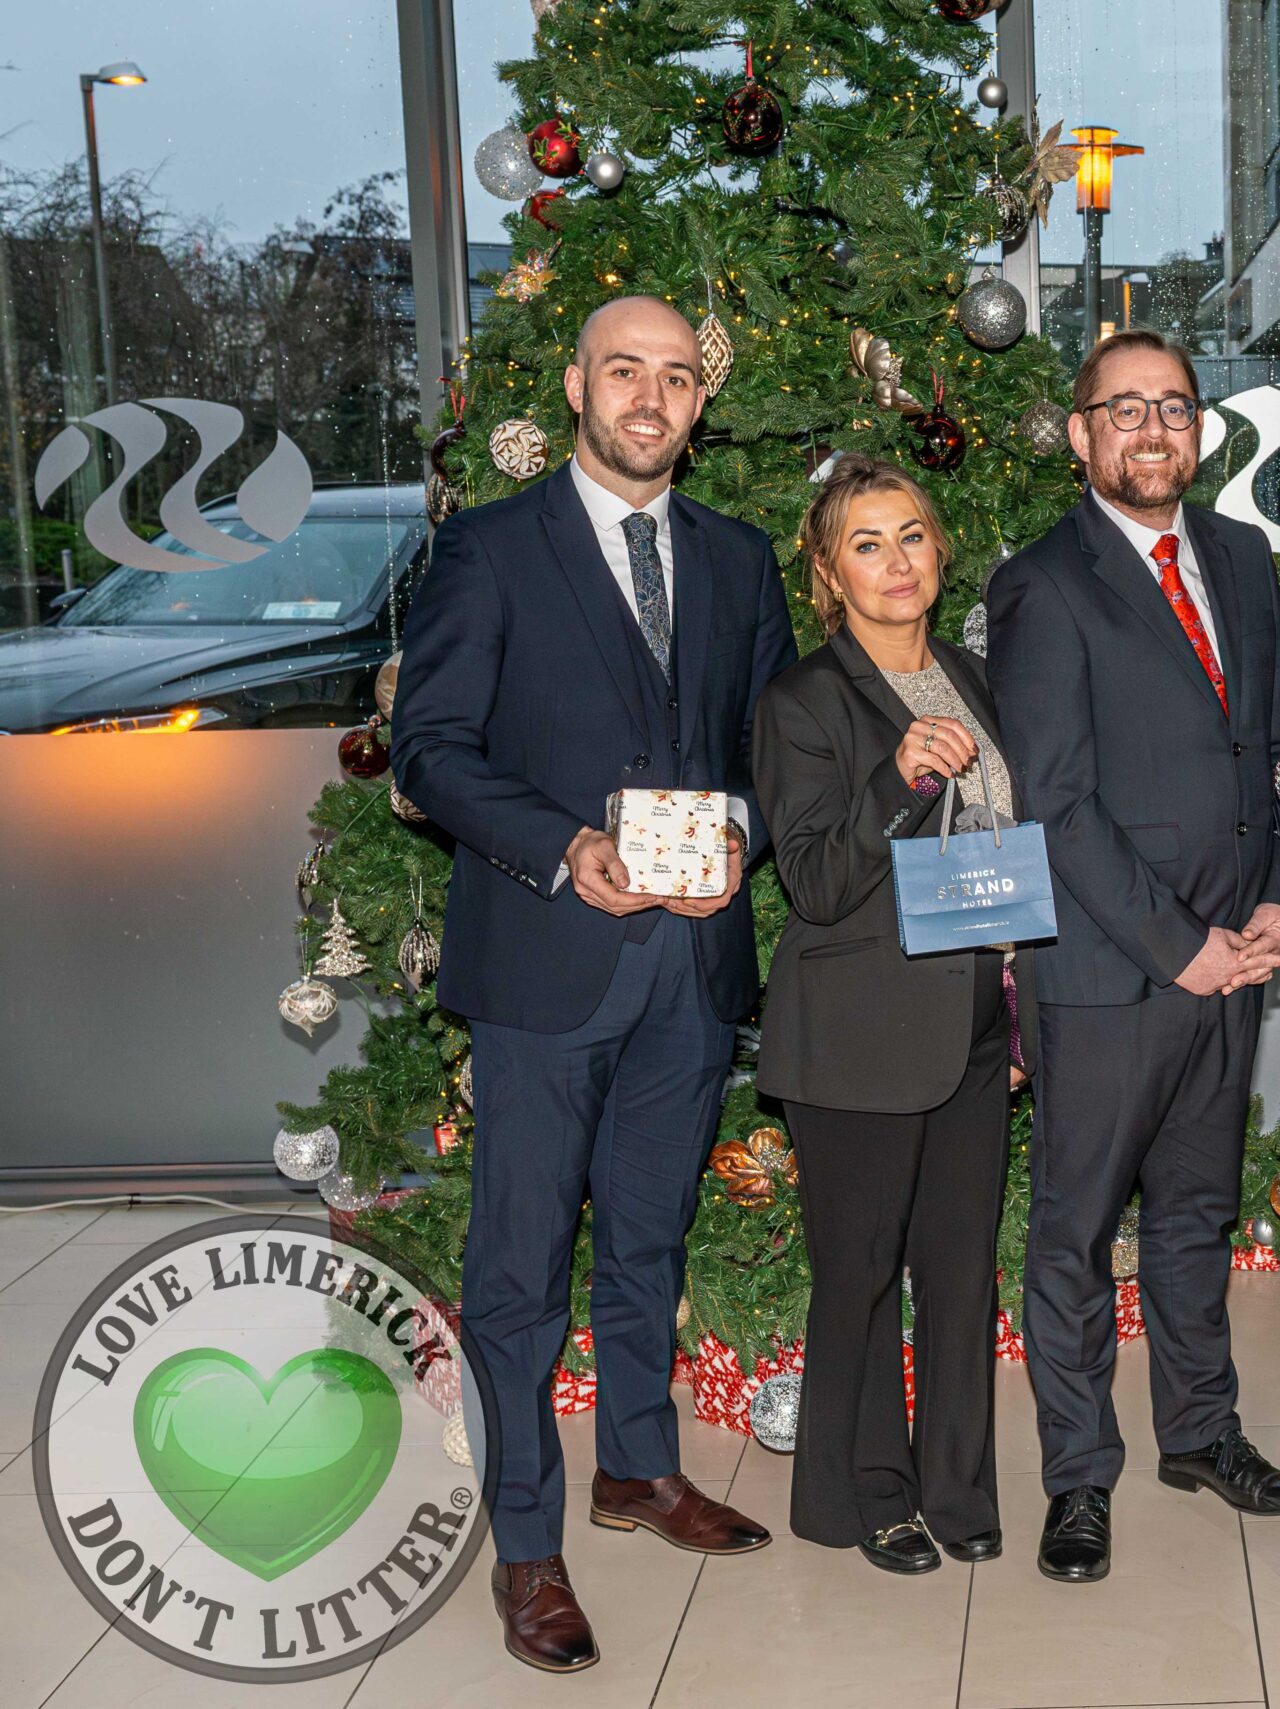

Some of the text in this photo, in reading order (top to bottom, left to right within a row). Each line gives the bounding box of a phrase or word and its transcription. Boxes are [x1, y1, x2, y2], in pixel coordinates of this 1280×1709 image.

[951, 868, 996, 881] LIMERICK
[936, 878, 1015, 900] STRAND
[962, 898, 993, 910] HOTEL
